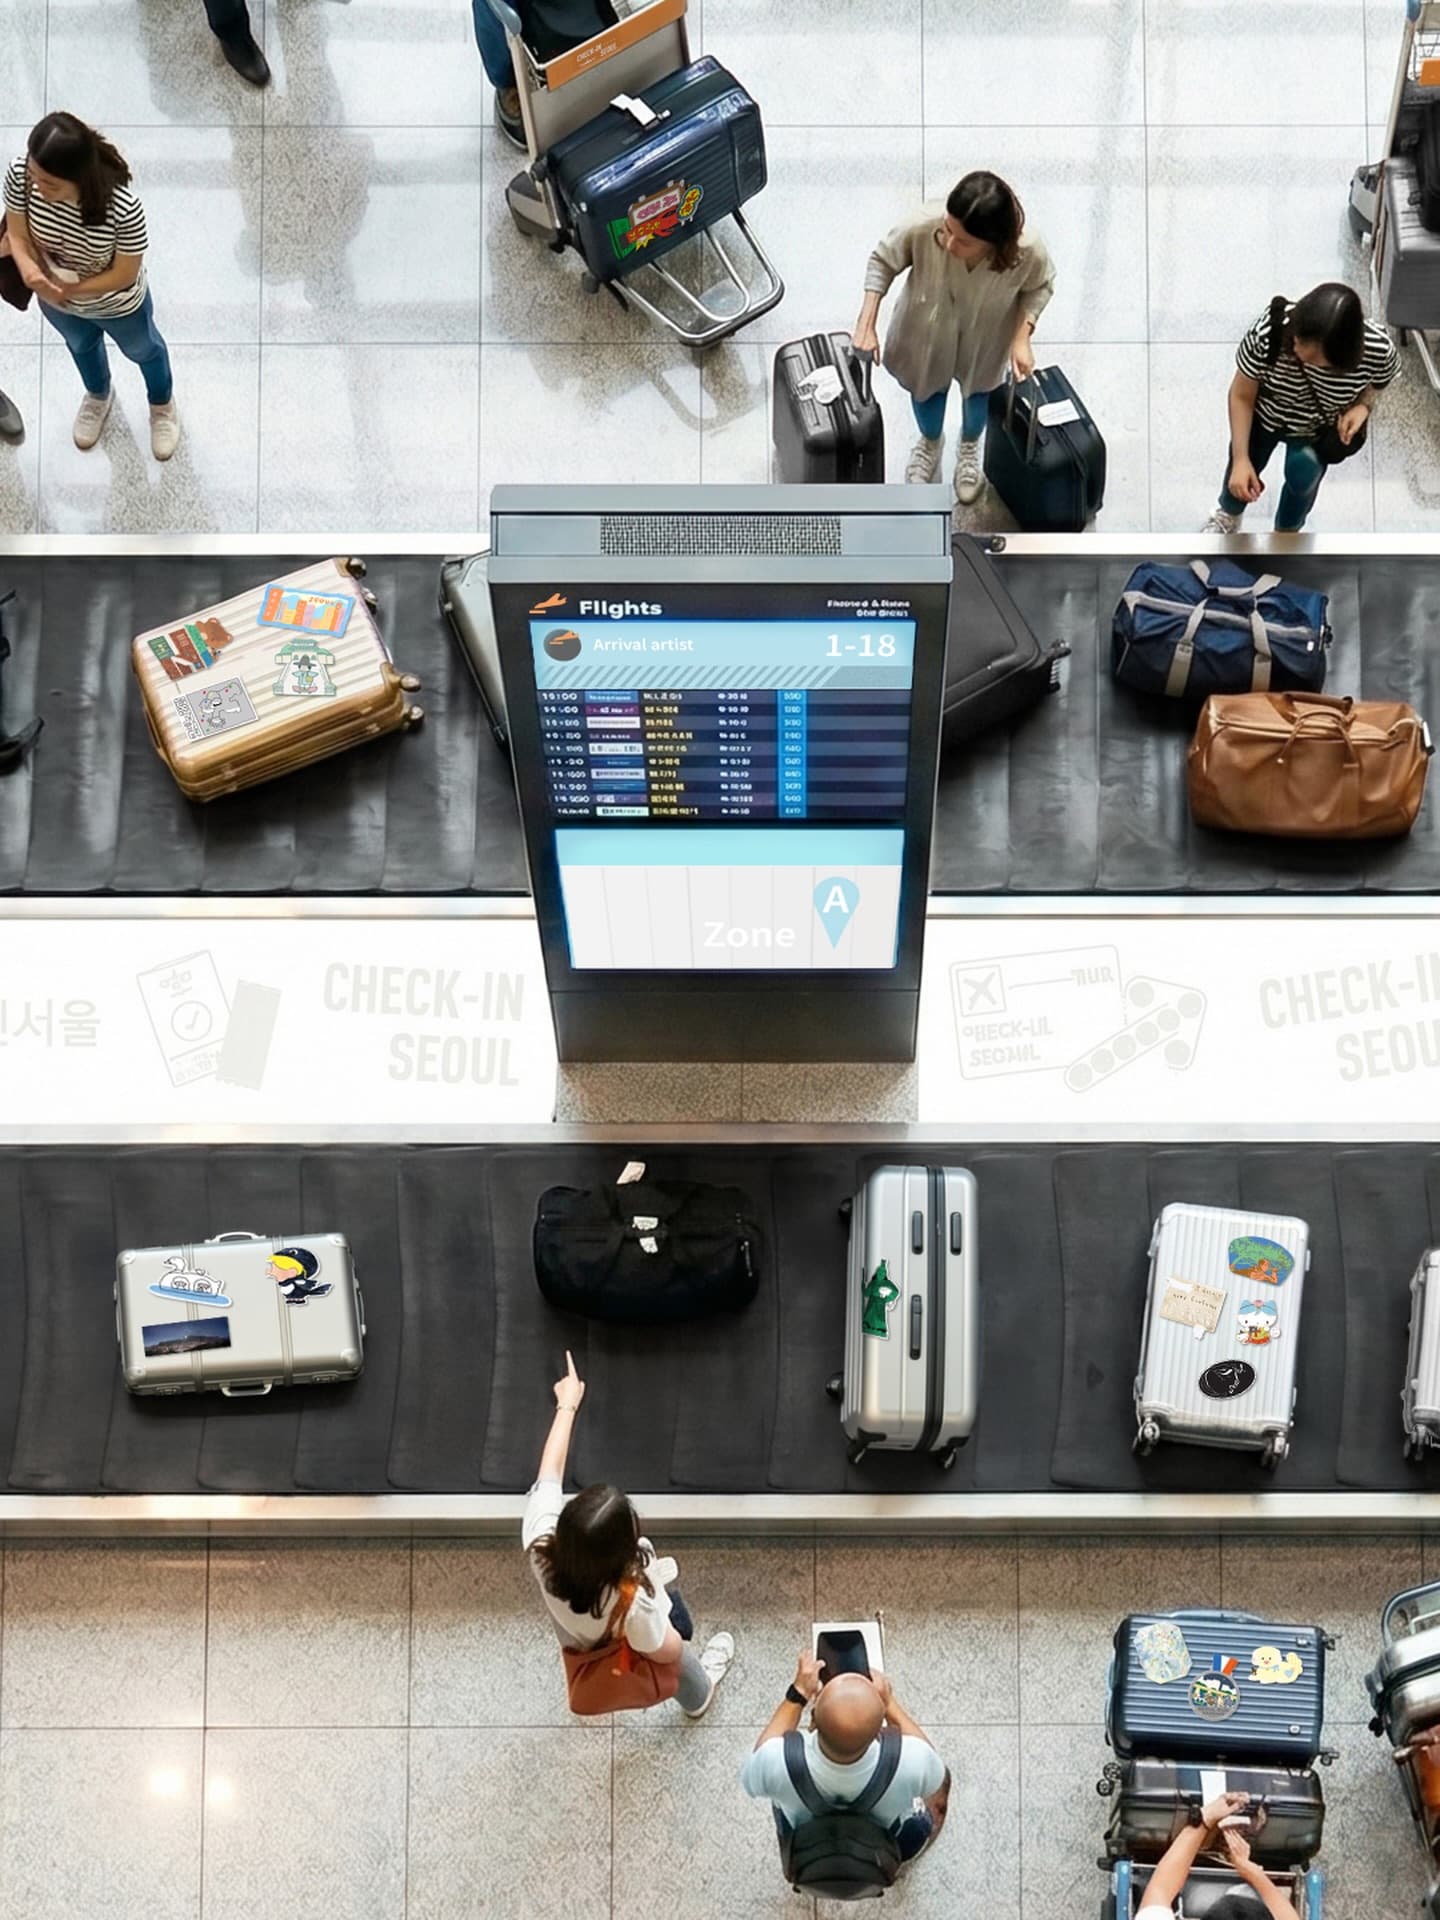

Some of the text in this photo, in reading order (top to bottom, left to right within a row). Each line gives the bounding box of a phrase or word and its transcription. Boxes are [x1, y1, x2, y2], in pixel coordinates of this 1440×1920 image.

[579, 600, 662, 620] Flights
[593, 638, 694, 652] Arrival artist
[825, 634, 896, 657] 1-18
[822, 885, 850, 913] A
[703, 921, 796, 948] Zone
[324, 962, 525, 1022] CHECK-IN
[389, 1033, 519, 1087] SEOUL
